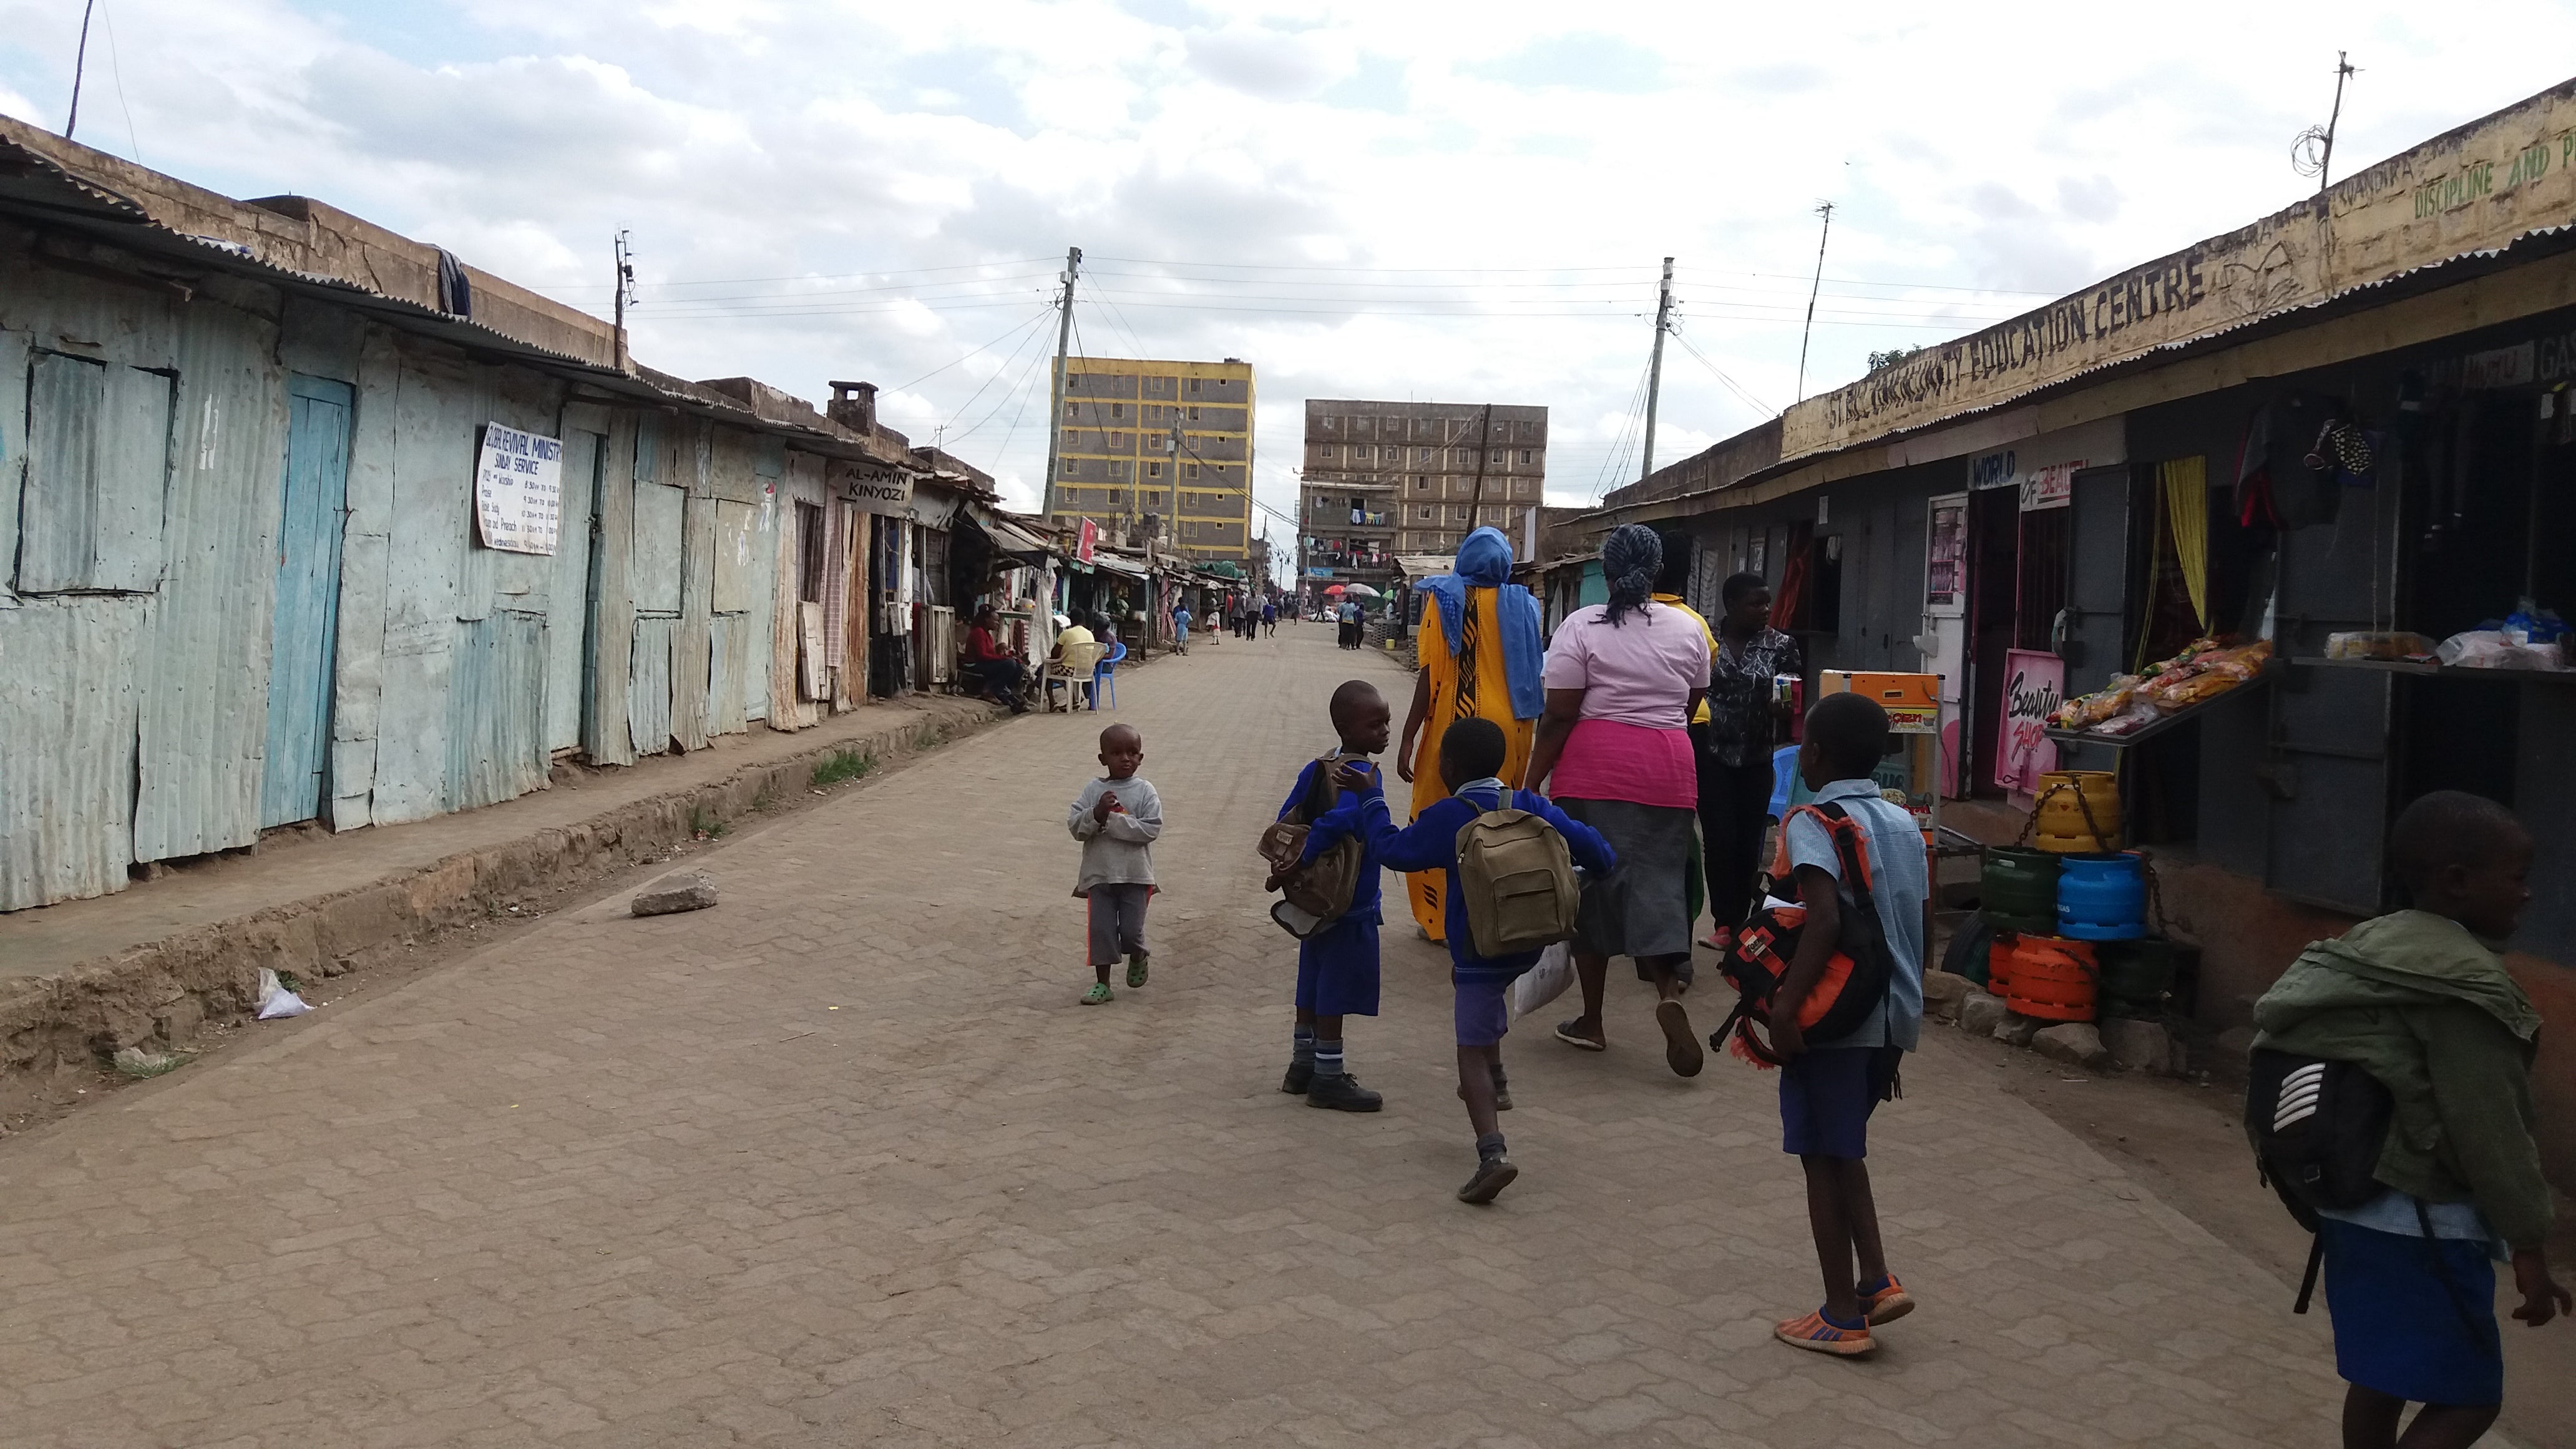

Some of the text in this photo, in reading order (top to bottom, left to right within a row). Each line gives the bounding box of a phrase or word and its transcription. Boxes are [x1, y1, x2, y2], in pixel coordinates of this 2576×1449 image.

[2415, 162, 2495, 219] DISCIPLINE
[2508, 144, 2550, 187] AND
[1969, 297, 2087, 381] EDUCATION
[2094, 253, 2206, 341] CENTRE
[495, 452, 539, 476] SUNDAY SERVICE
[502, 430, 529, 456] REVIVAL
[532, 438, 562, 463] MINISTRY
[846, 468, 908, 485] AL-AMIN
[849, 482, 905, 502] KINYOZI
[1973, 450, 2090, 507] WORLD OF BEAU
[501, 517, 517, 532] Preach
[2009, 671, 2059, 720] Beauty
[2012, 720, 2046, 763] SHOP
